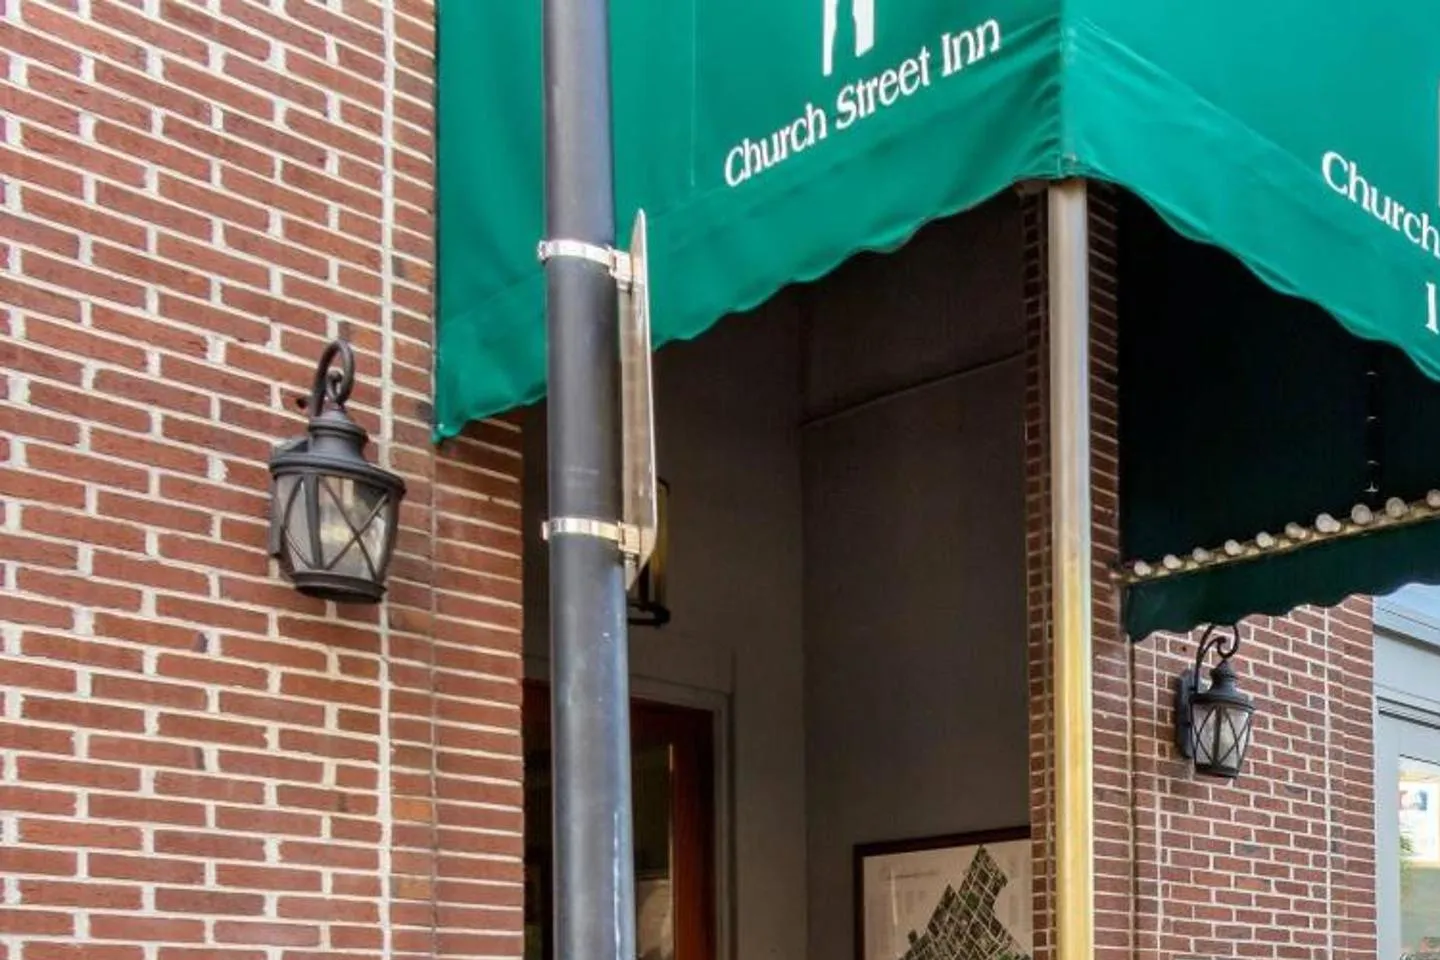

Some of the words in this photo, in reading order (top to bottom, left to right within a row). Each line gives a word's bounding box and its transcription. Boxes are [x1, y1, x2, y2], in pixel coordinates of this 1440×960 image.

[724, 103, 827, 187] Church
[835, 46, 930, 129] Street
[941, 18, 1000, 76] Inn
[1322, 151, 1440, 258] Church
